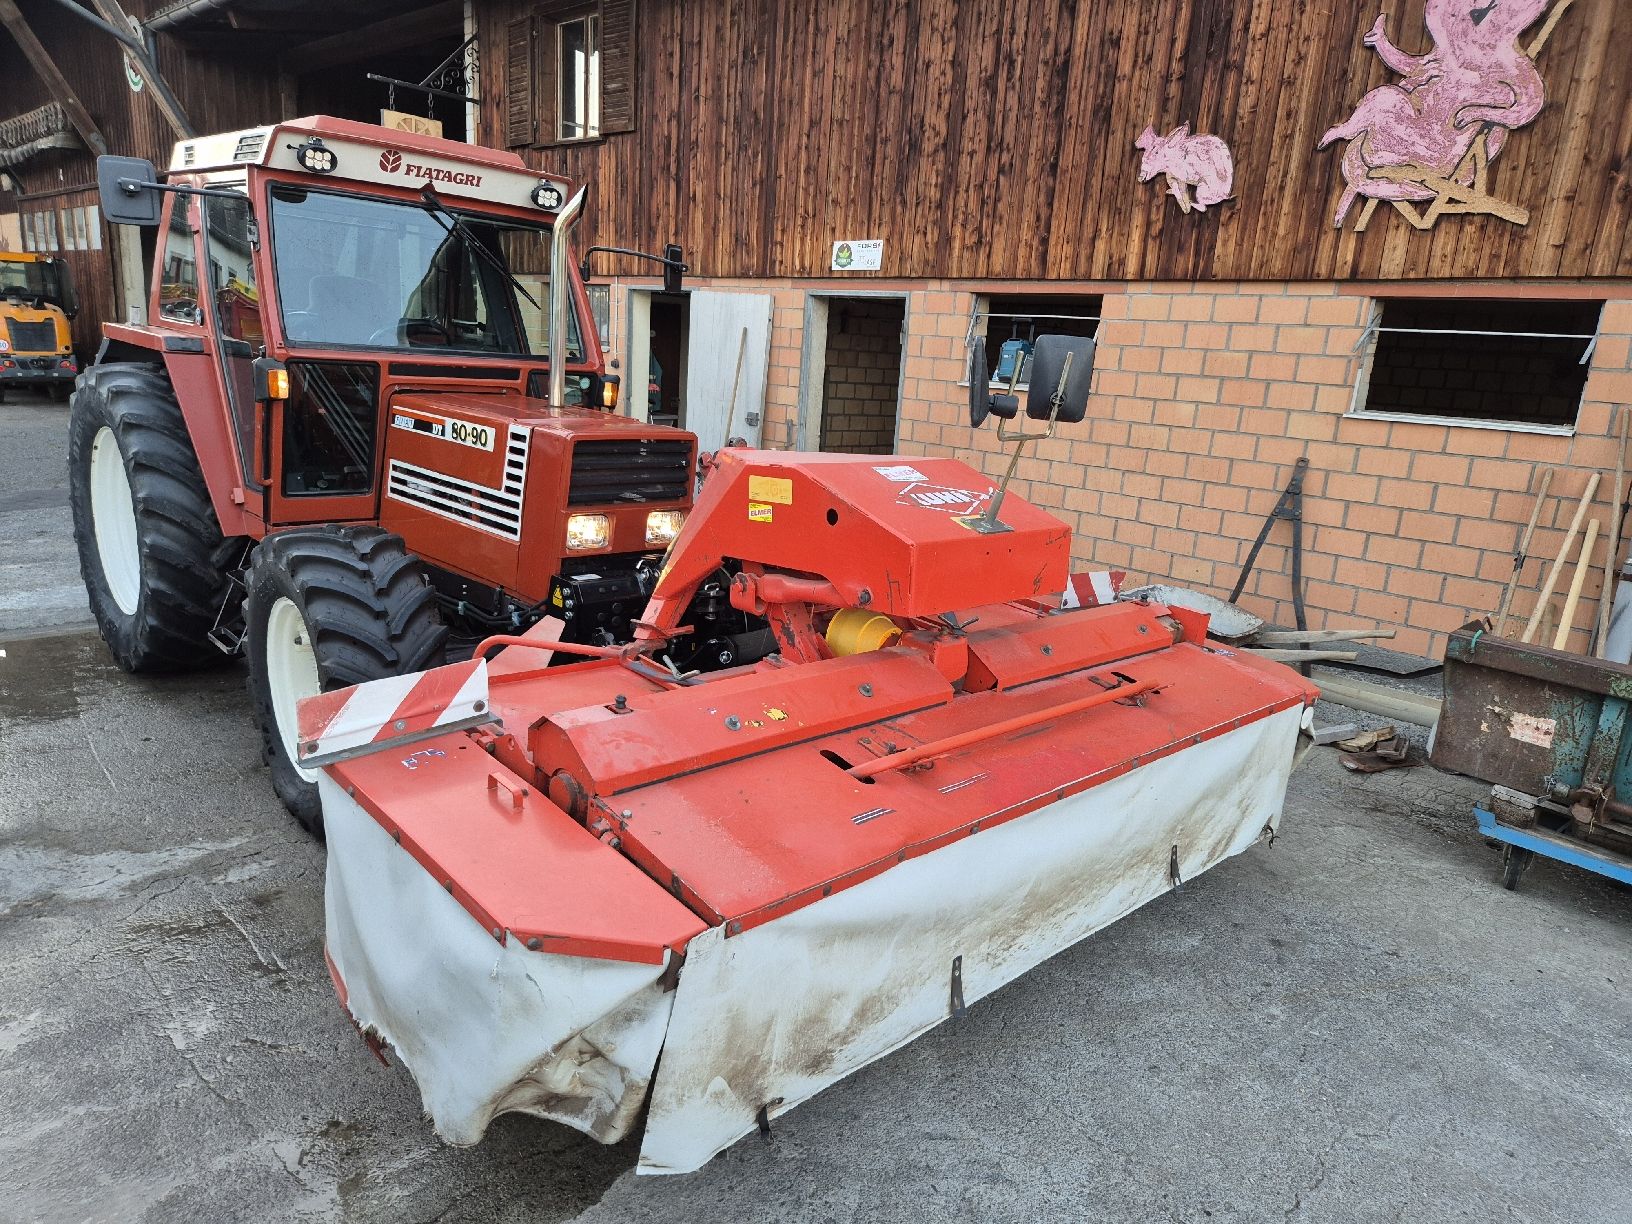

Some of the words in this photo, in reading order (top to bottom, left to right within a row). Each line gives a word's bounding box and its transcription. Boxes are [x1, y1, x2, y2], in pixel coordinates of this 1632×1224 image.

[404, 164, 483, 187] FIATAGRI
[432, 423, 443, 436] DT
[750, 508, 772, 517] ELMER
